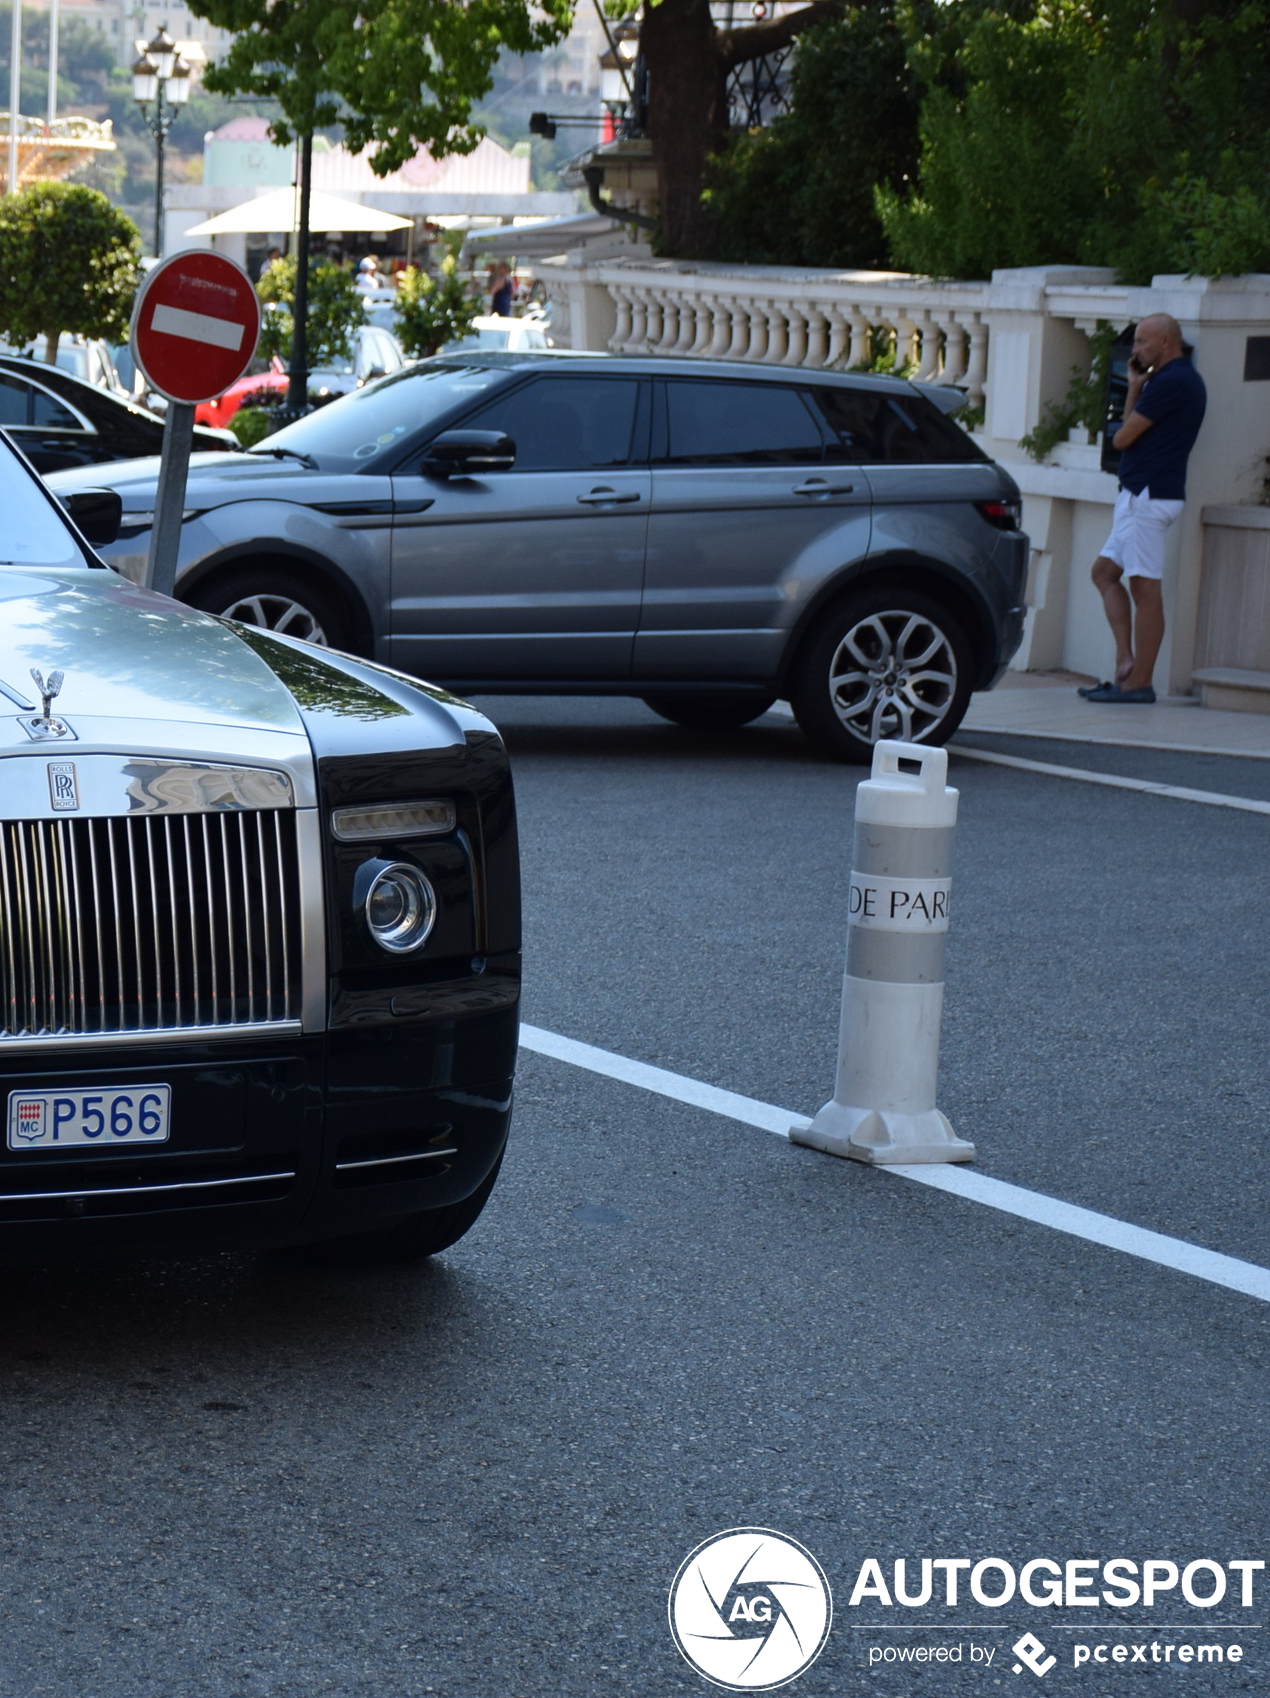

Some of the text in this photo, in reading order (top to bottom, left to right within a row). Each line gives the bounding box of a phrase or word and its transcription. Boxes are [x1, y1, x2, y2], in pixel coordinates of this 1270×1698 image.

[849, 885, 877, 917] DE
[20, 1121, 39, 1133] MC
[52, 1093, 162, 1140] P566
